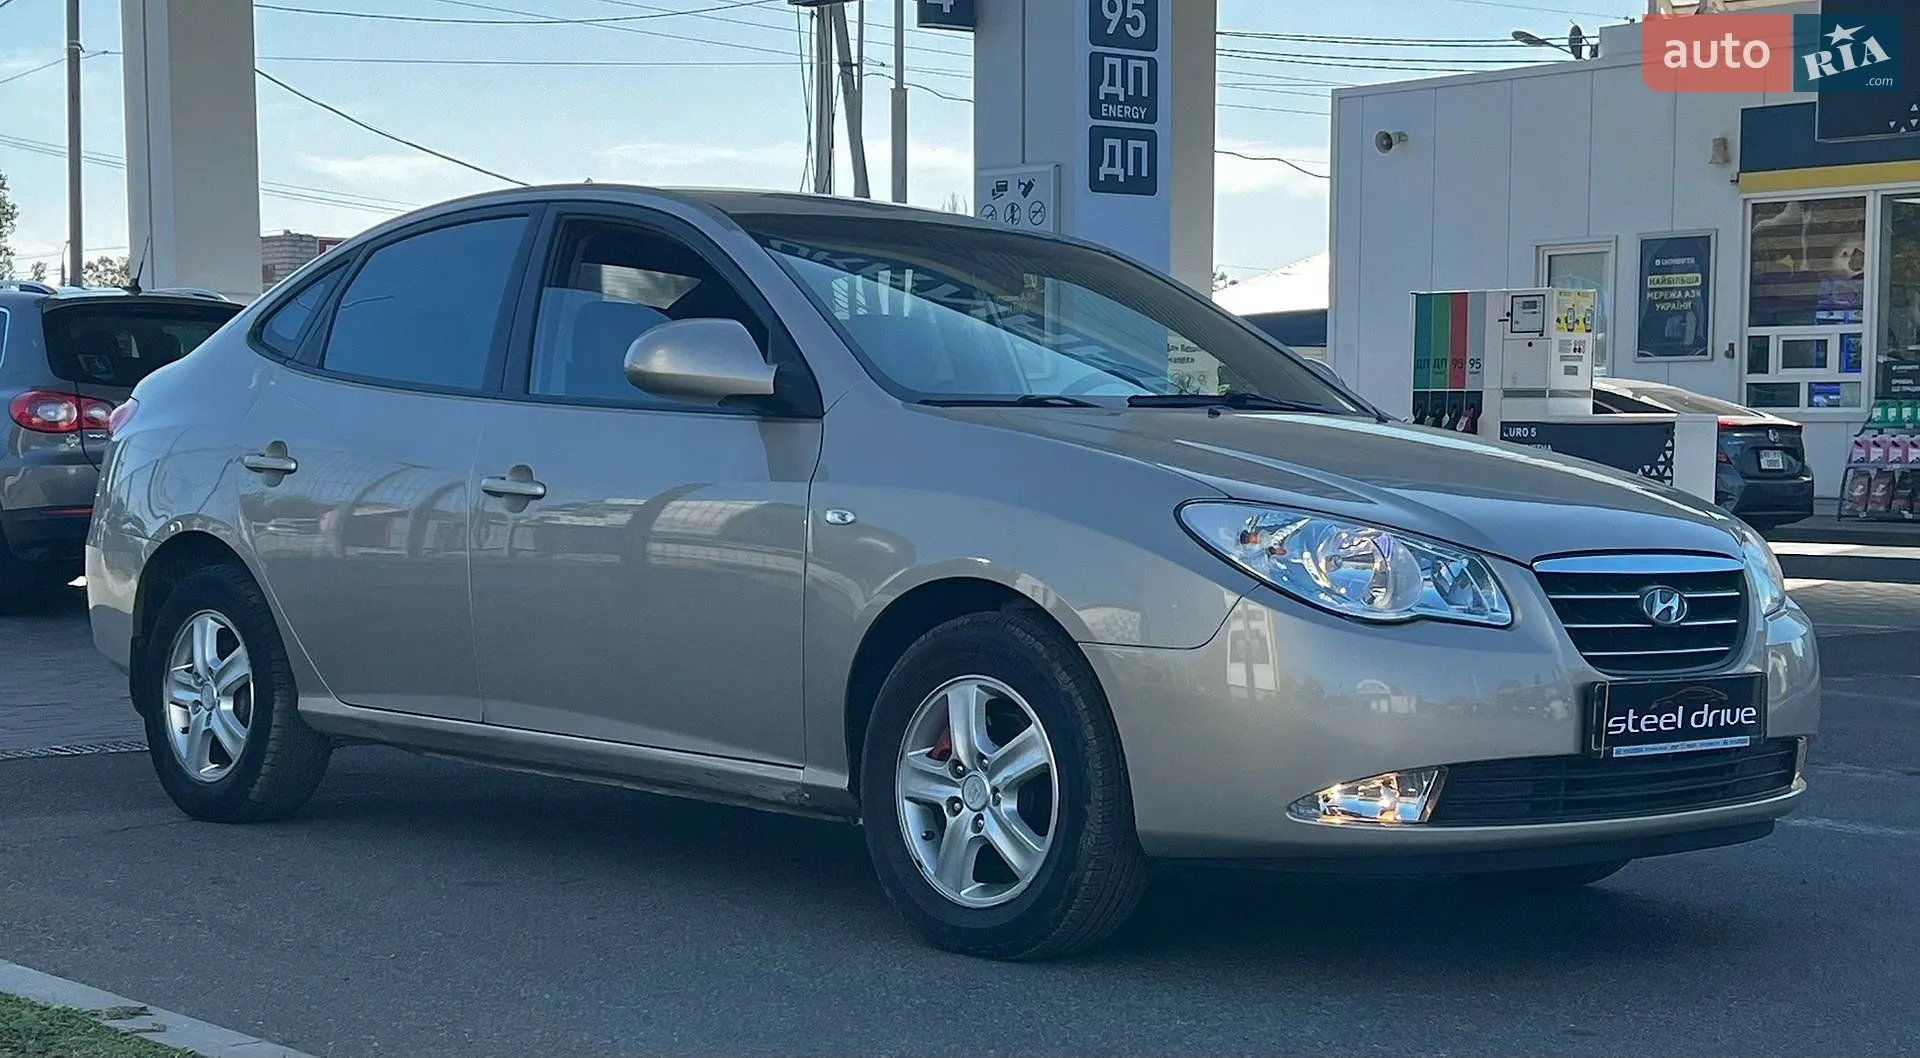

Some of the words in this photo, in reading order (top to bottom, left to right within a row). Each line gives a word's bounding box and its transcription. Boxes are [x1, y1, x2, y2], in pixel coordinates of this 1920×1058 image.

[1101, 0, 1148, 38] 95
[1099, 57, 1149, 102] ДП
[1101, 103, 1148, 120] ENERGY
[1099, 138, 1149, 183] ДП
[1451, 357, 1465, 370] 95
[1469, 357, 1482, 370] 95
[1530, 427, 1537, 438] 5
[1608, 705, 1684, 735] steel
[1690, 704, 1757, 729] drive
